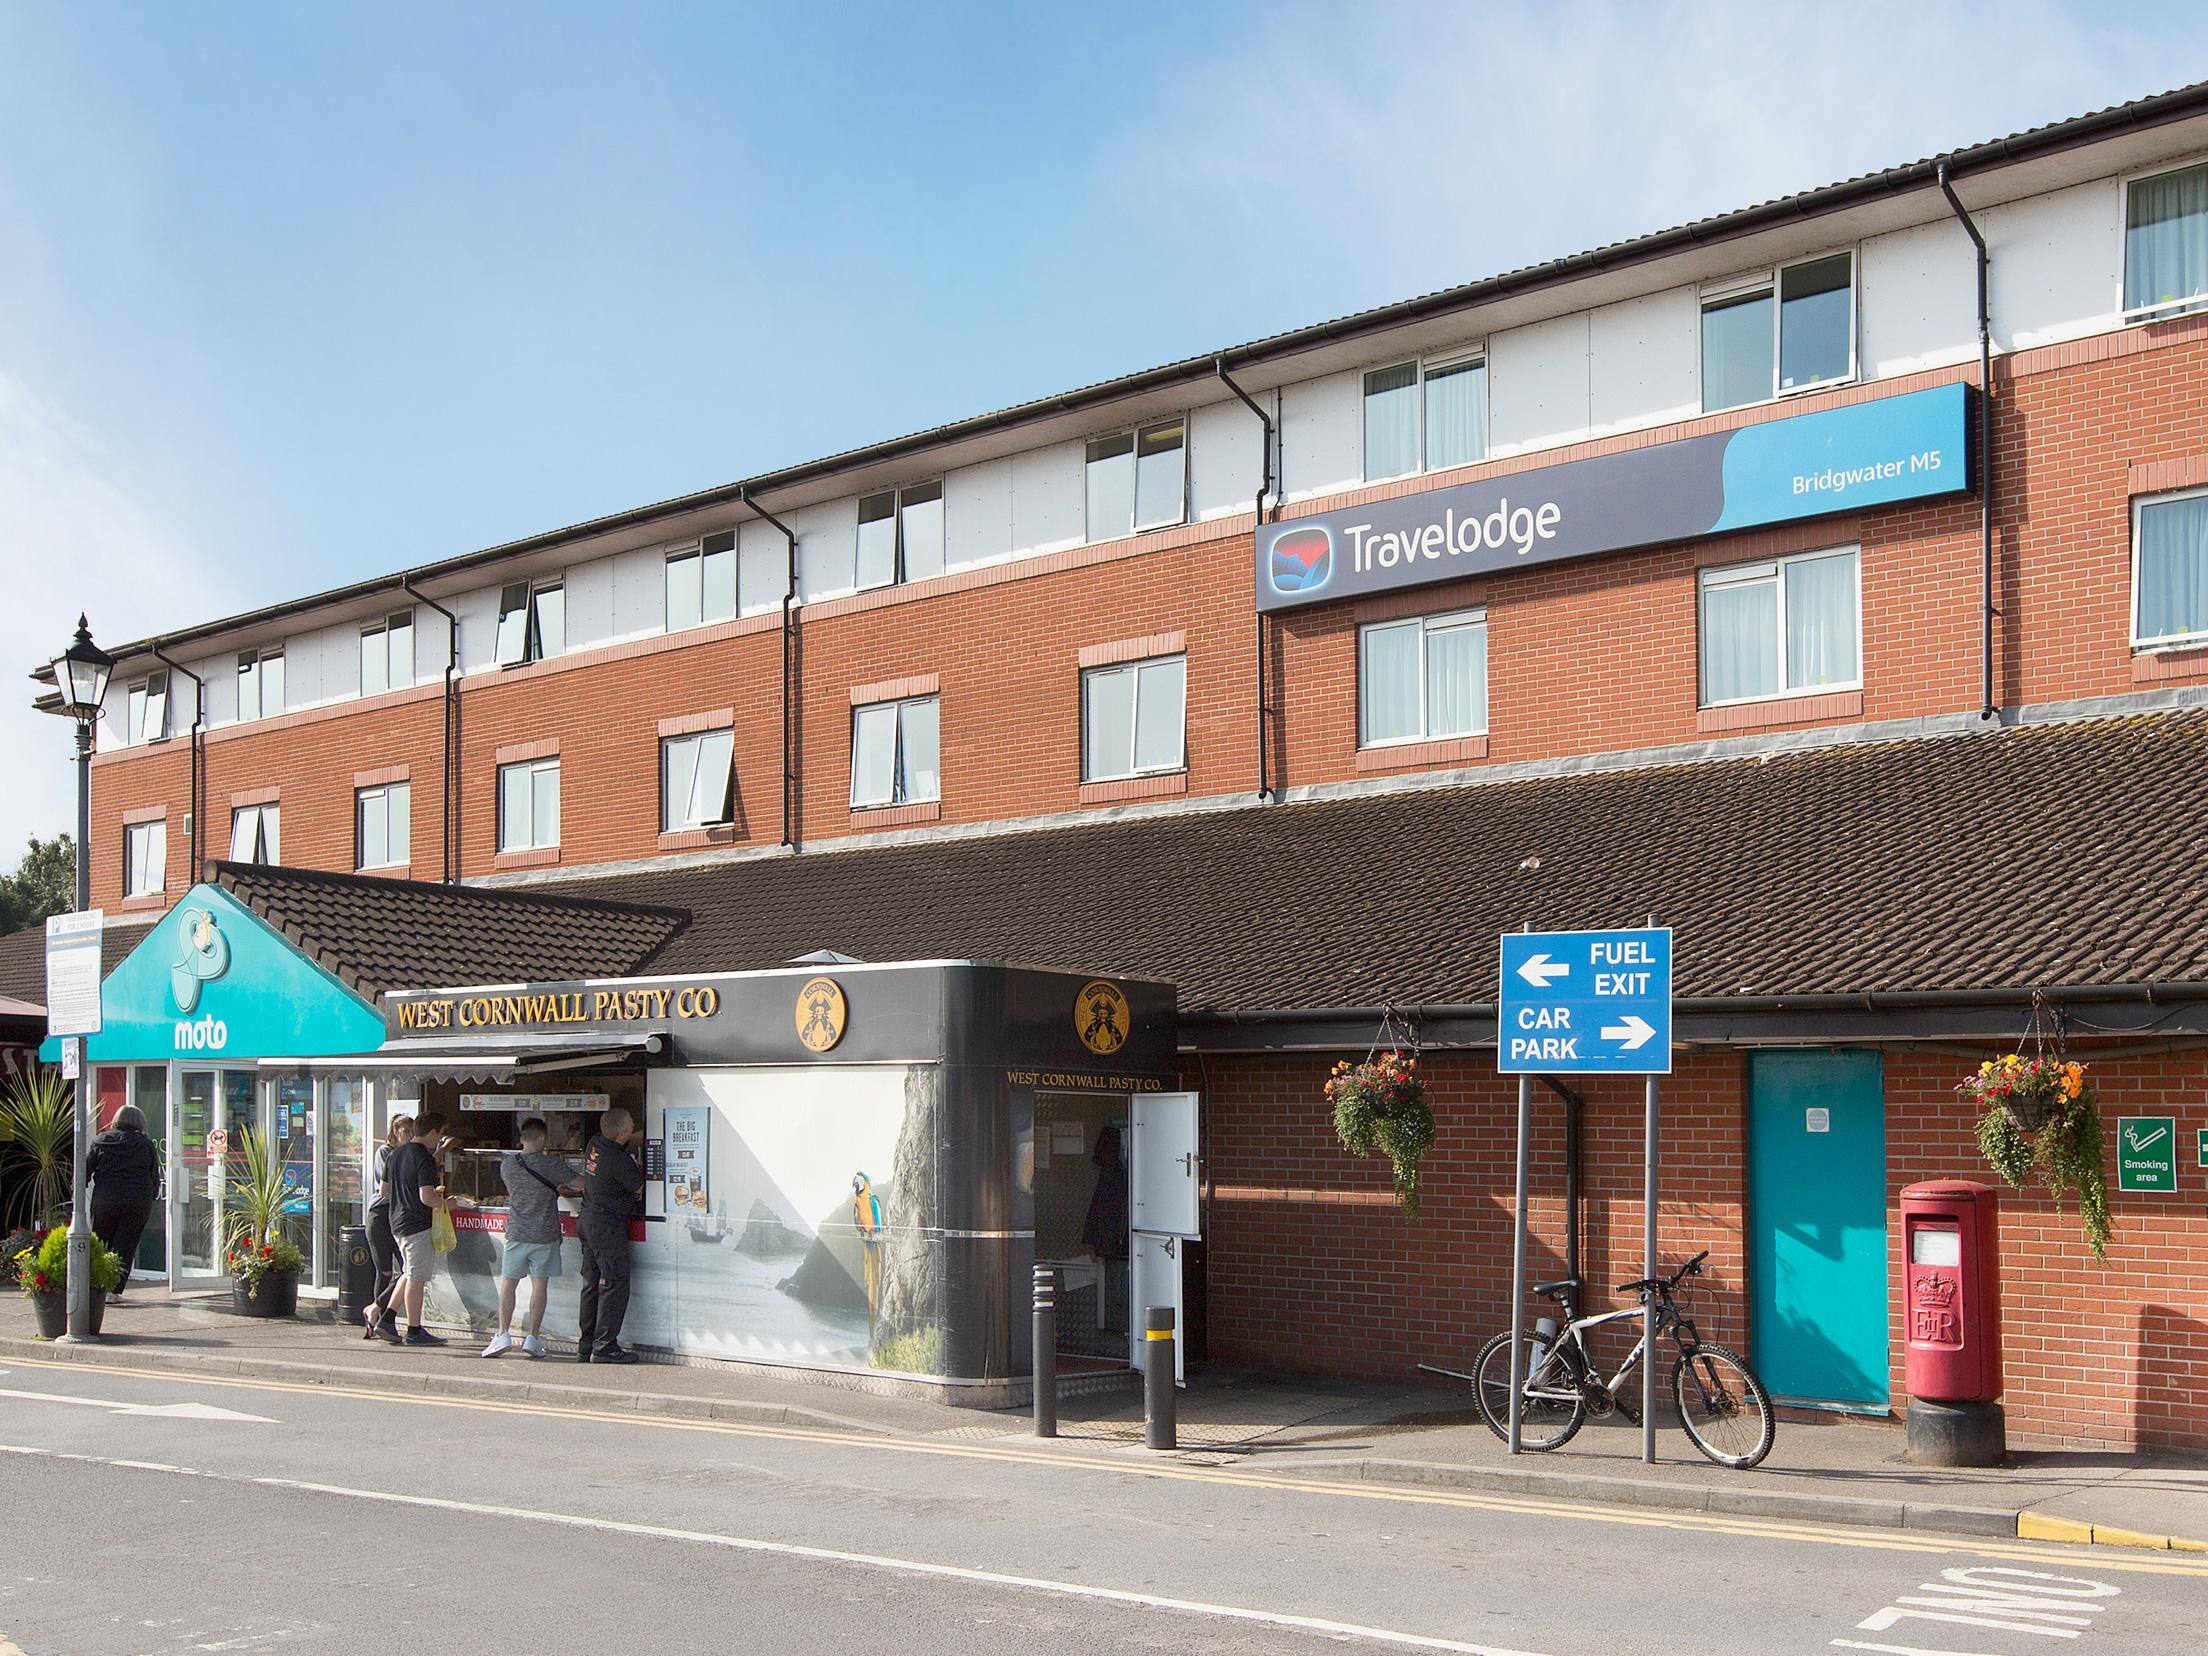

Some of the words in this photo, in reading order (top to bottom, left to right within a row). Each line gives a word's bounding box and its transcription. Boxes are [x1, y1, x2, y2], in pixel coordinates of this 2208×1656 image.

[1793, 460, 1905, 494] Bridgwater
[1911, 450, 1941, 473] M5
[1344, 498, 1561, 573] Travelodge
[1590, 942, 1656, 964] FUEL
[1595, 973, 1651, 995] EXIT
[397, 1000, 455, 1029] WEST
[459, 995, 588, 1027] CORNWALL
[594, 988, 671, 1021] PASTY
[677, 986, 718, 1018] CO
[1518, 1008, 1571, 1029] CAR
[175, 1014, 227, 1050] moto
[1511, 1038, 1578, 1060] PARK
[1007, 1071, 1039, 1085] WEST
[1042, 1073, 1107, 1088] CORNWALL
[1109, 1077, 1143, 1090] PASTY
[1145, 1079, 1163, 1091] CO.
[672, 1132, 700, 1142] BREAKFAST
[676, 1121, 686, 1132] THE
[687, 1121, 696, 1131] BIG
[2124, 1160, 2168, 1171] Smoking
[456, 1217, 504, 1230] HANDMADE
